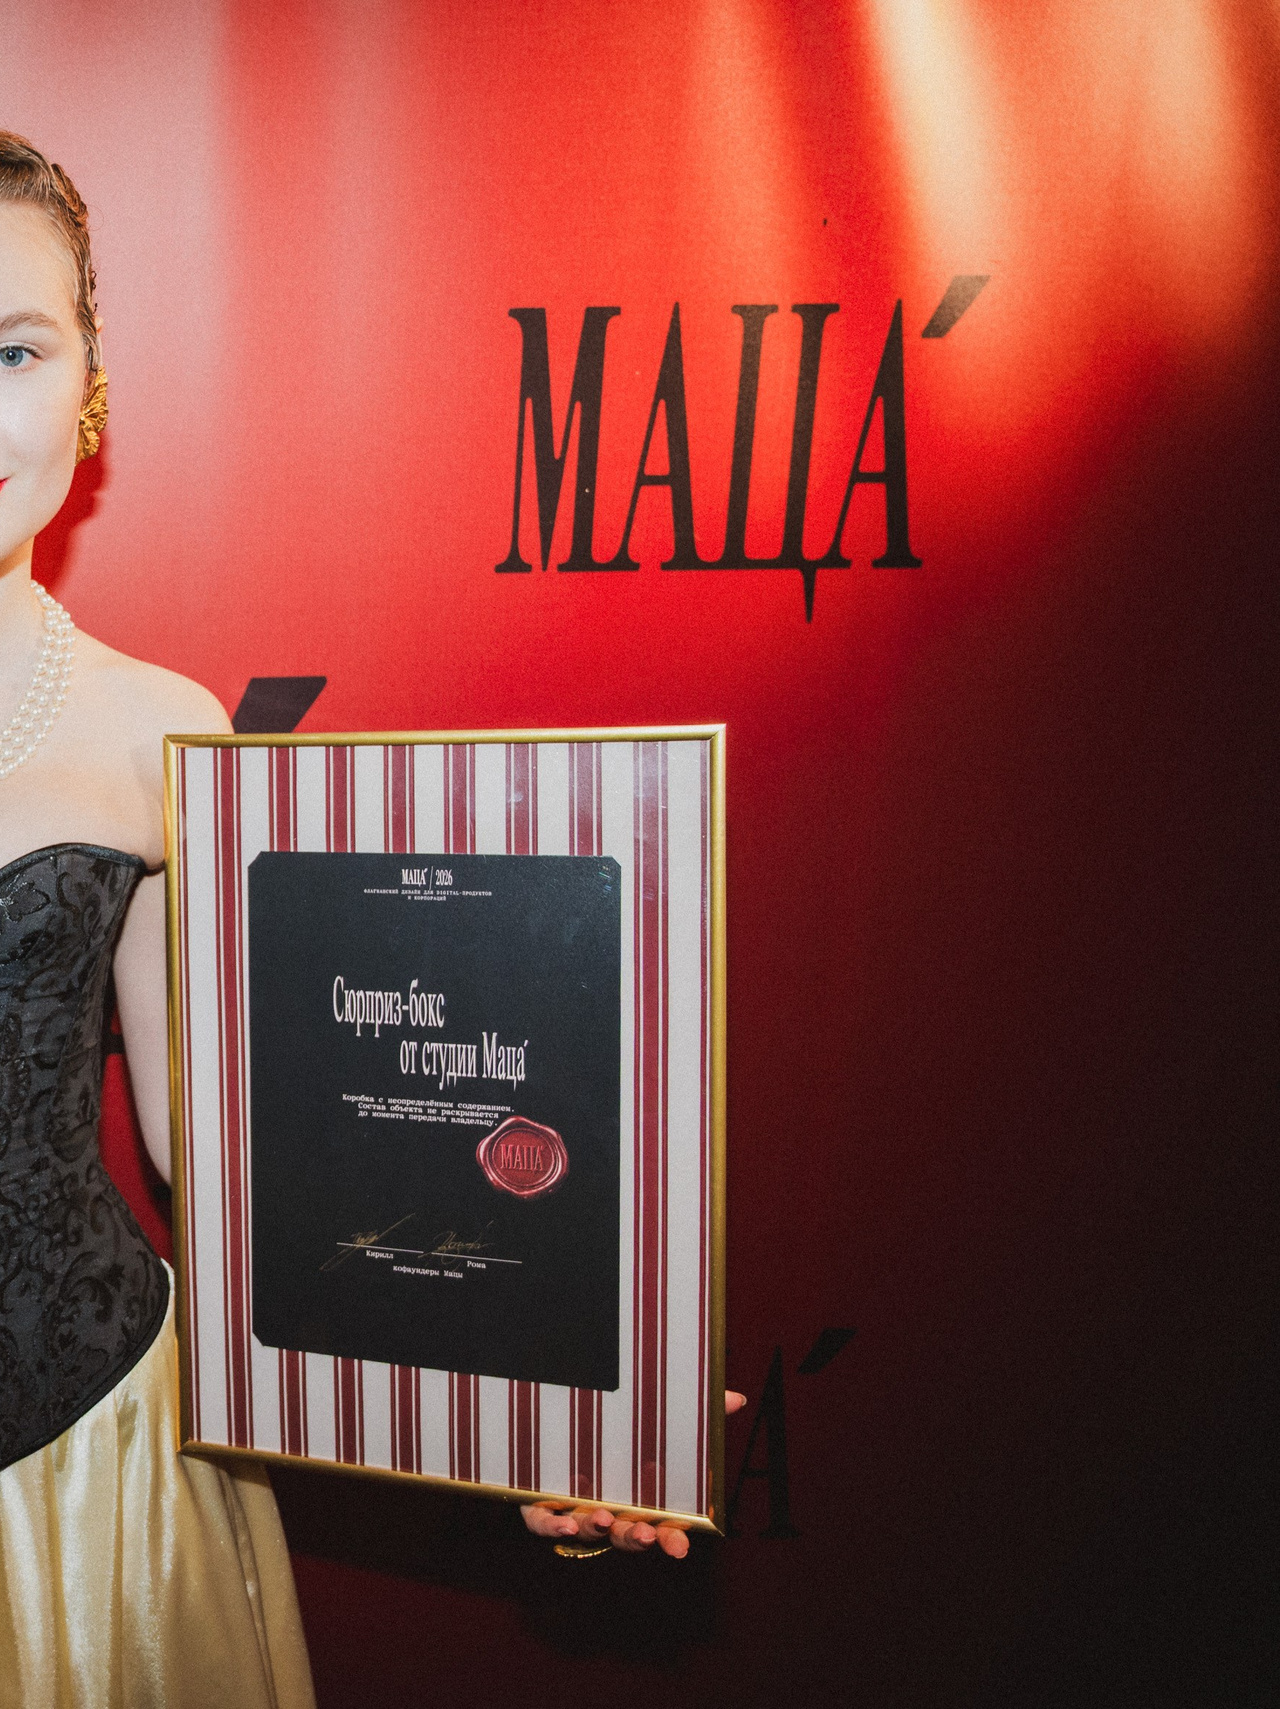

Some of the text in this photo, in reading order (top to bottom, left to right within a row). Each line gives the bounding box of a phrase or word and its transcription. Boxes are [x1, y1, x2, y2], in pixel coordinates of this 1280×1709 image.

[435, 868, 453, 886] 2026
[333, 975, 445, 1037] Сюрприз-бокс
[400, 1040, 418, 1075] от
[422, 1041, 477, 1090] студии
[342, 1093, 375, 1102] Коробка
[387, 1097, 453, 1108] неопределённым
[457, 1102, 515, 1112] содержанием.
[357, 1102, 387, 1111] Состав
[389, 1104, 423, 1113] объекта
[441, 1109, 499, 1119] раскрывается
[371, 1111, 405, 1119] момента
[408, 1114, 447, 1122] передачи
[450, 1117, 498, 1127] владельцу.
[365, 1250, 394, 1260] Кирилл
[392, 1265, 464, 1279] кофаундеры Мацы
[466, 1261, 487, 1269] Рома
